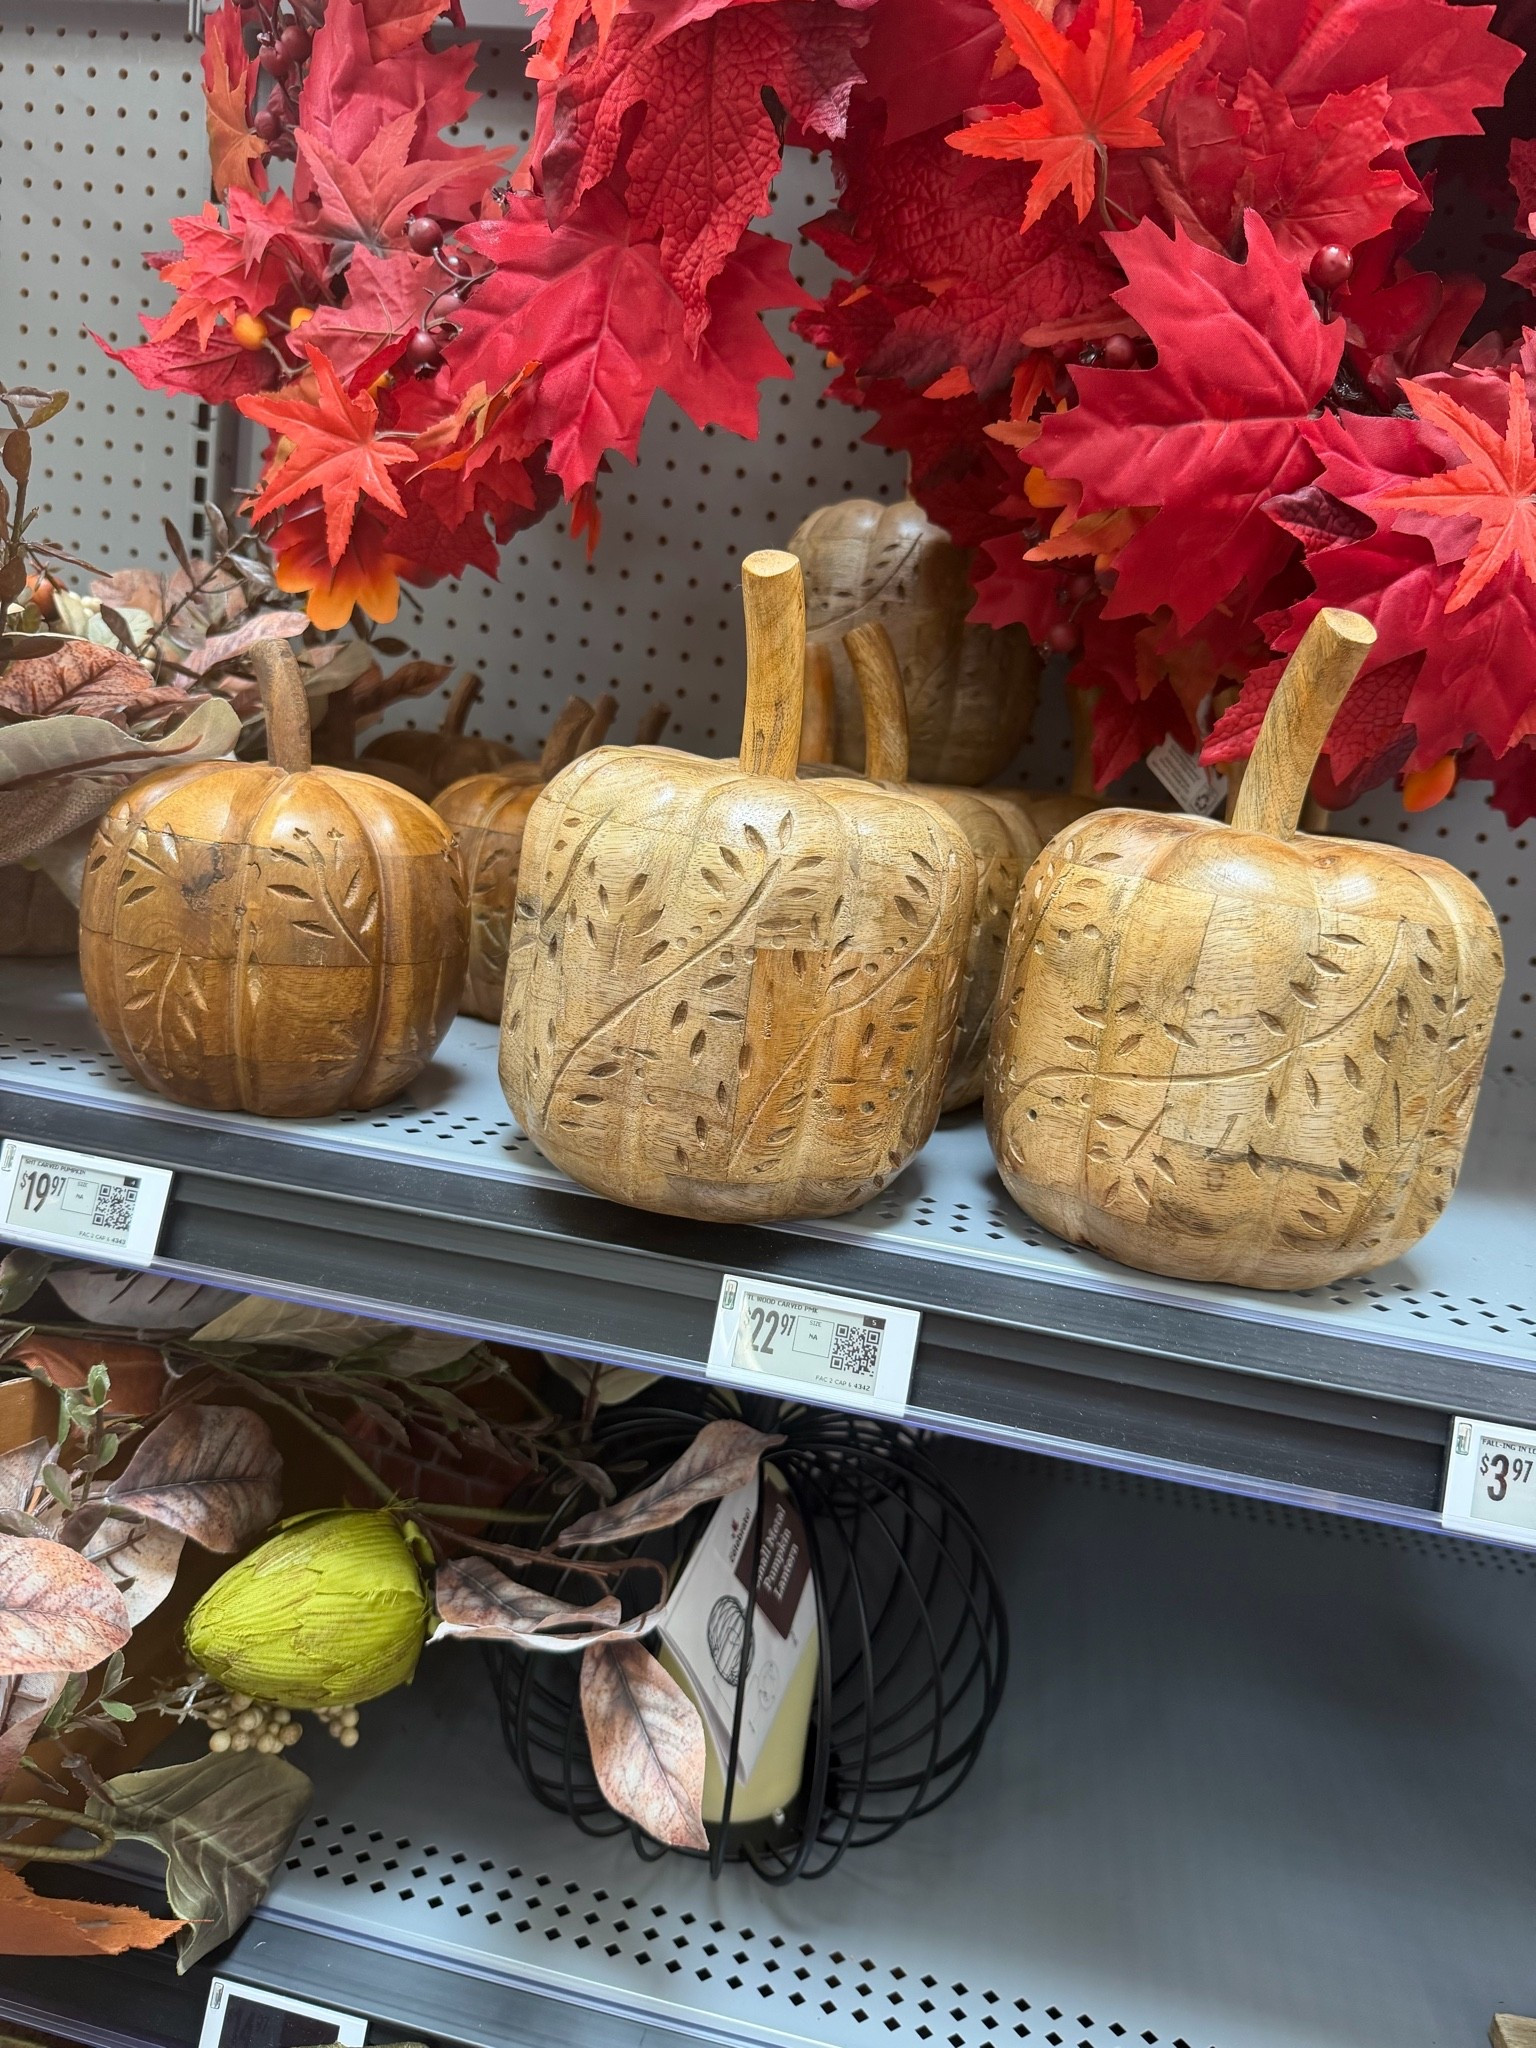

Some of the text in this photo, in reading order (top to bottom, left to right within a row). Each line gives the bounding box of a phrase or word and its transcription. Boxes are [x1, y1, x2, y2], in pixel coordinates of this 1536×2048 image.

[756, 1296, 776, 1305] WOOD
[777, 1300, 803, 1311] CARVED
[809, 1319, 822, 1328] SIZE
[808, 1333, 818, 1341] NA
[815, 1374, 828, 1383] FAC
[853, 1382, 871, 1392] 4342
[1482, 1438, 1516, 1450] FALL-ING
[1518, 1445, 1527, 1453] IN
[756, 1543, 771, 1590] mall
[763, 1528, 792, 1592] Pumpkin
[773, 1543, 799, 1602] Lantern
